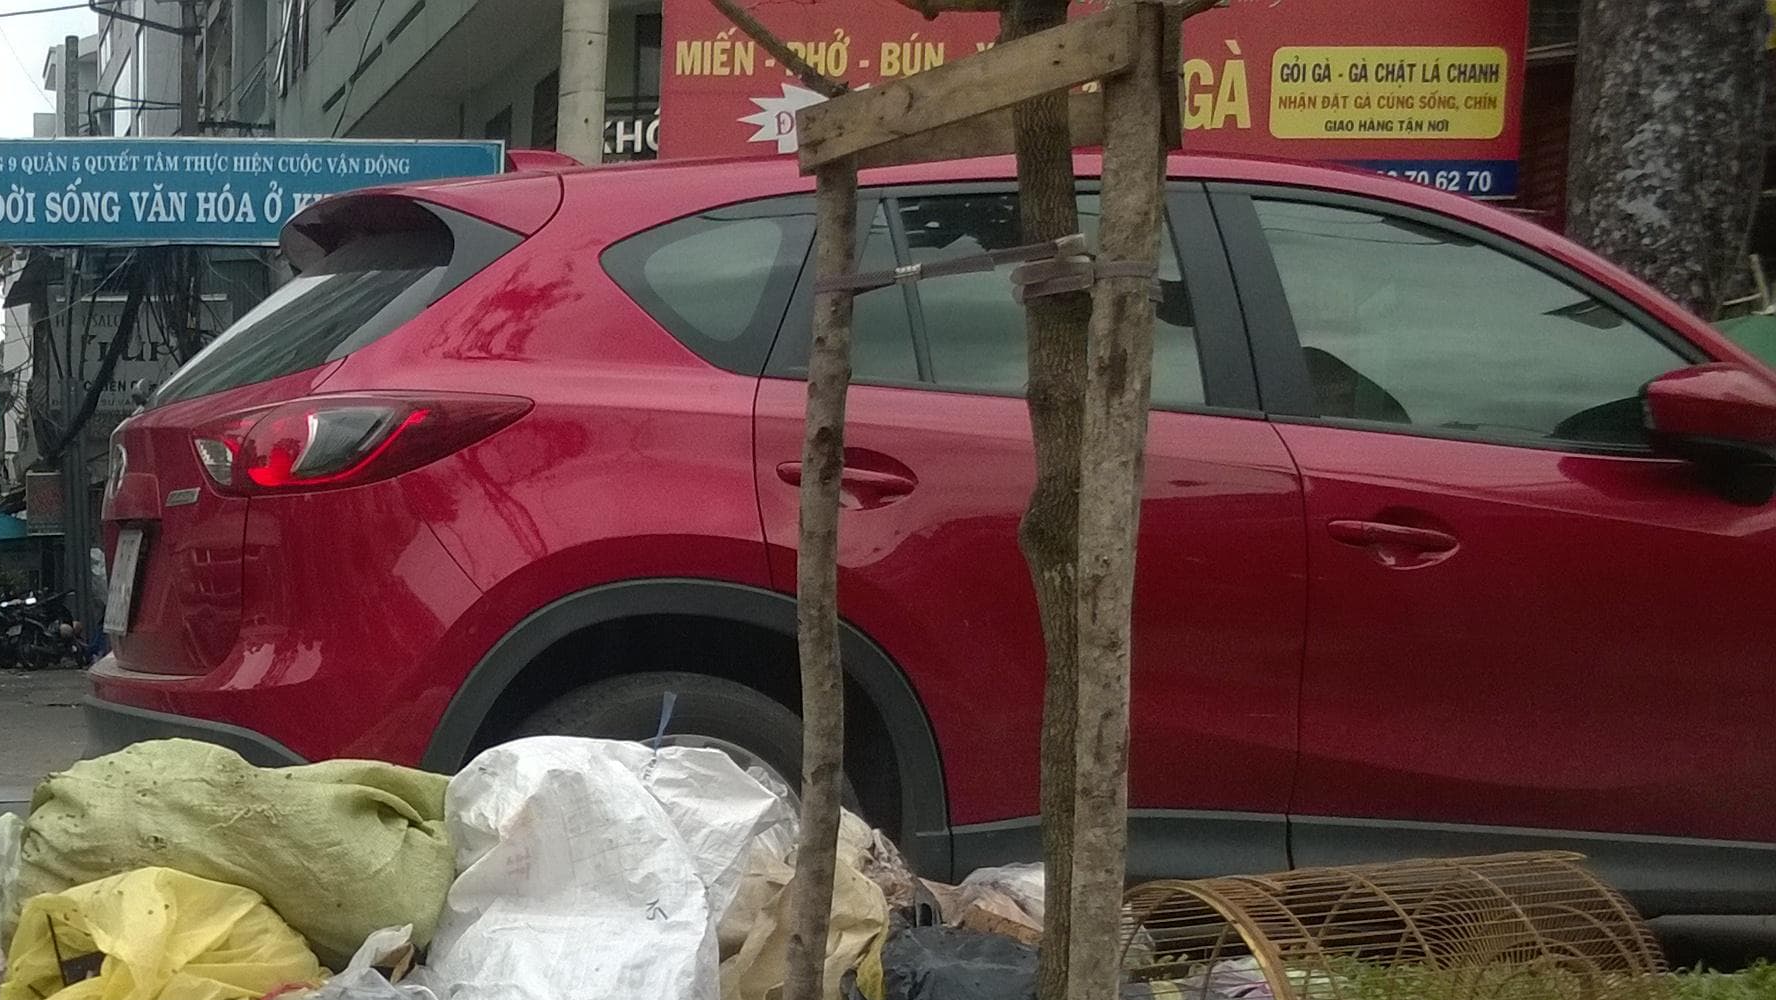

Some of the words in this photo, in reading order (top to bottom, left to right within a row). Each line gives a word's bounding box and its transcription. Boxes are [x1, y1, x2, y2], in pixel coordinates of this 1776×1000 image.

[675, 27, 755, 76] MIẾN
[786, 28, 851, 77] PHỞ
[880, 32, 945, 76] BÚN
[1280, 55, 1306, 83] GỎI
[1312, 58, 1331, 83] GÀ
[1348, 58, 1368, 83] GÀ
[1421, 58, 1441, 83] LÁ
[1447, 63, 1500, 84] CHANH
[1182, 39, 1251, 130] GÀ
[1278, 92, 1316, 111] NHẬN
[1354, 92, 1372, 109] GÀ
[1377, 91, 1414, 109] CÚNG
[1418, 90, 1459, 111] SỐNG,
[1464, 92, 1497, 109] CHÍN
[1324, 119, 1354, 132] GIAO
[1358, 117, 1393, 132] HÀNG
[1398, 117, 1423, 134] TẬN
[1427, 119, 1449, 132] NƠI
[8, 156, 17, 172] 9
[21, 151, 68, 176] QUẬN
[72, 156, 80, 172] 5
[85, 148, 140, 175] QUYẾT
[144, 151, 179, 172] TÂM
[183, 153, 229, 175] THỰC
[232, 152, 274, 175] HIỆN
[278, 152, 322, 176] CUỘC
[327, 152, 361, 177] VẬN
[364, 152, 411, 178] ĐỘNG
[1435, 170, 1460, 191] 62
[1466, 170, 1492, 192] 70
[45, 177, 121, 225] SỐNG
[128, 182, 187, 224] VĂN
[196, 183, 257, 223] HÓA
[264, 180, 283, 223] Ở
